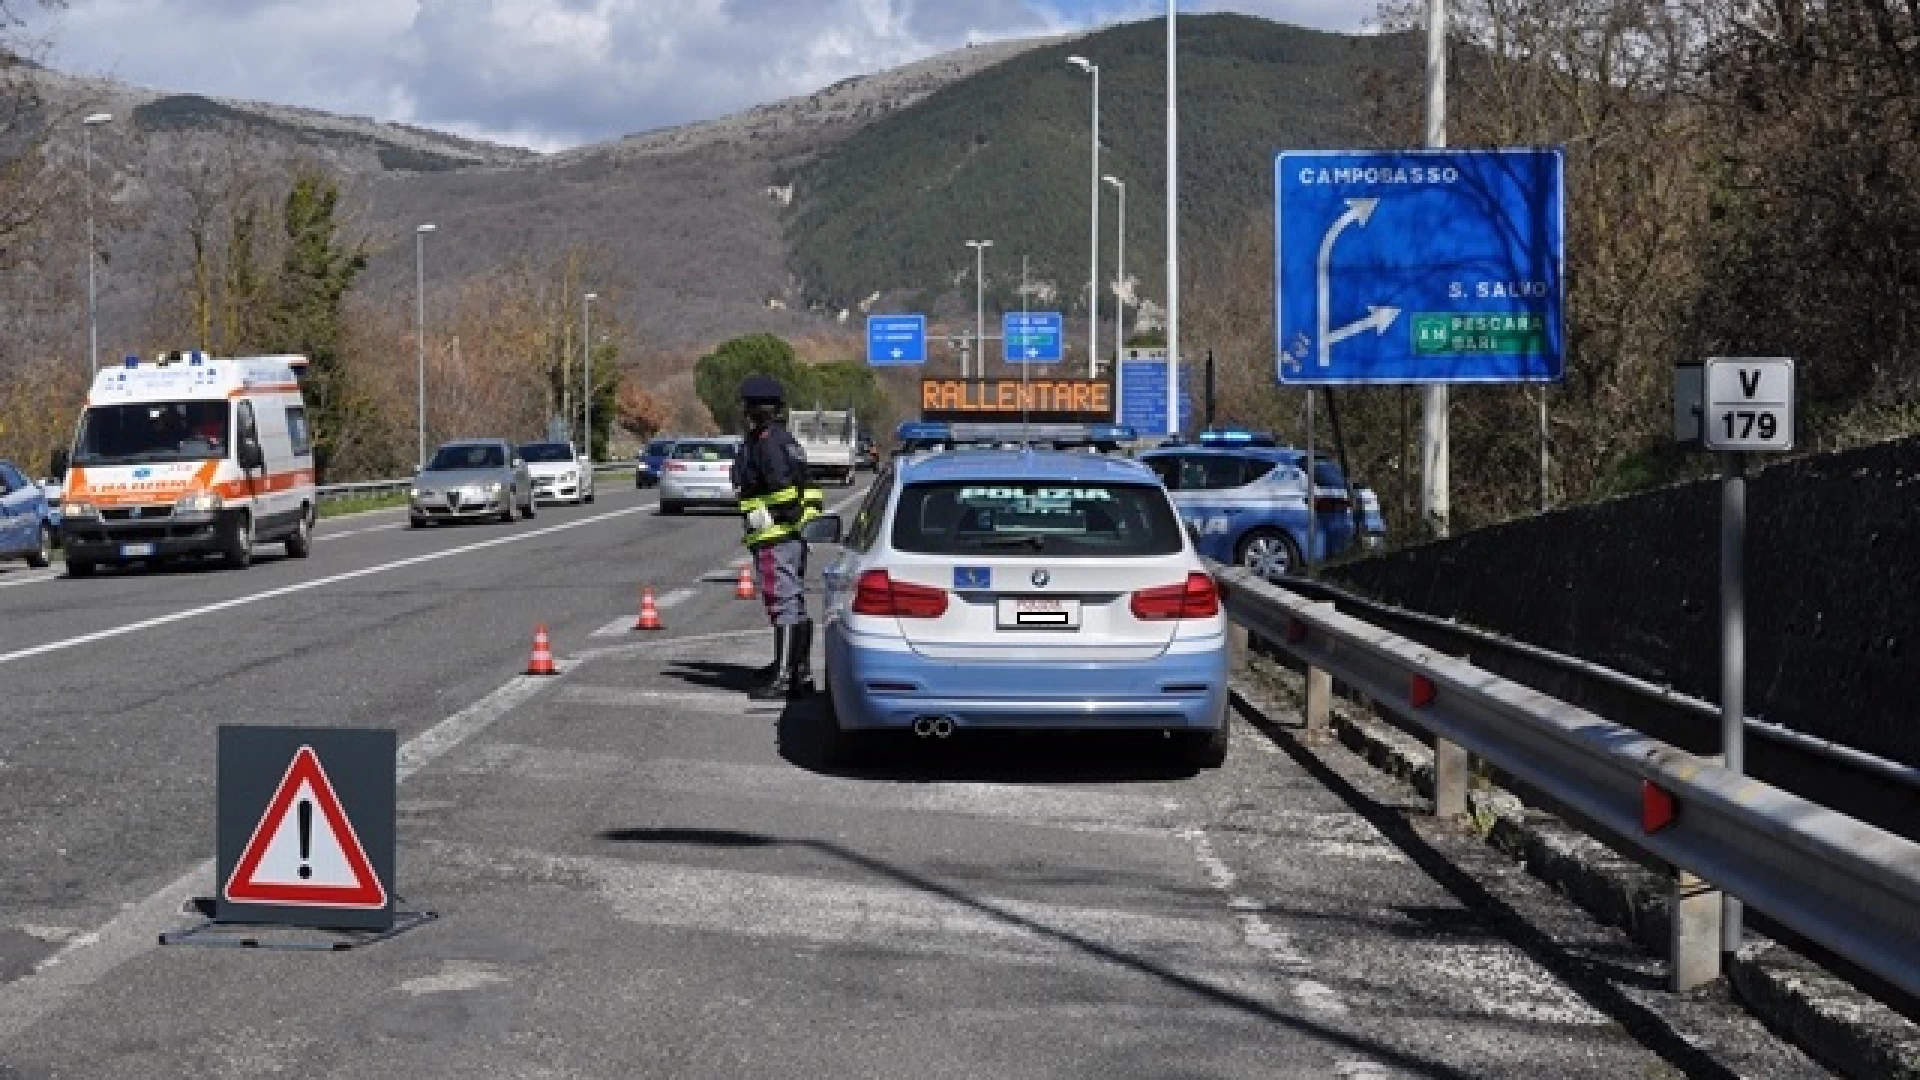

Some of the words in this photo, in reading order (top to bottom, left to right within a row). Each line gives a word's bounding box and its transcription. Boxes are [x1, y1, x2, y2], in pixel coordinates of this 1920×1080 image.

[1299, 167, 1459, 185] CAMPOBASSO
[1449, 281, 1468, 298] S.
[1476, 281, 1546, 298] SALVO
[1451, 318, 1543, 331] PESCARA
[1737, 369, 1761, 399] V
[923, 383, 1111, 412] RALLENTARE
[1722, 411, 1777, 441] 179
